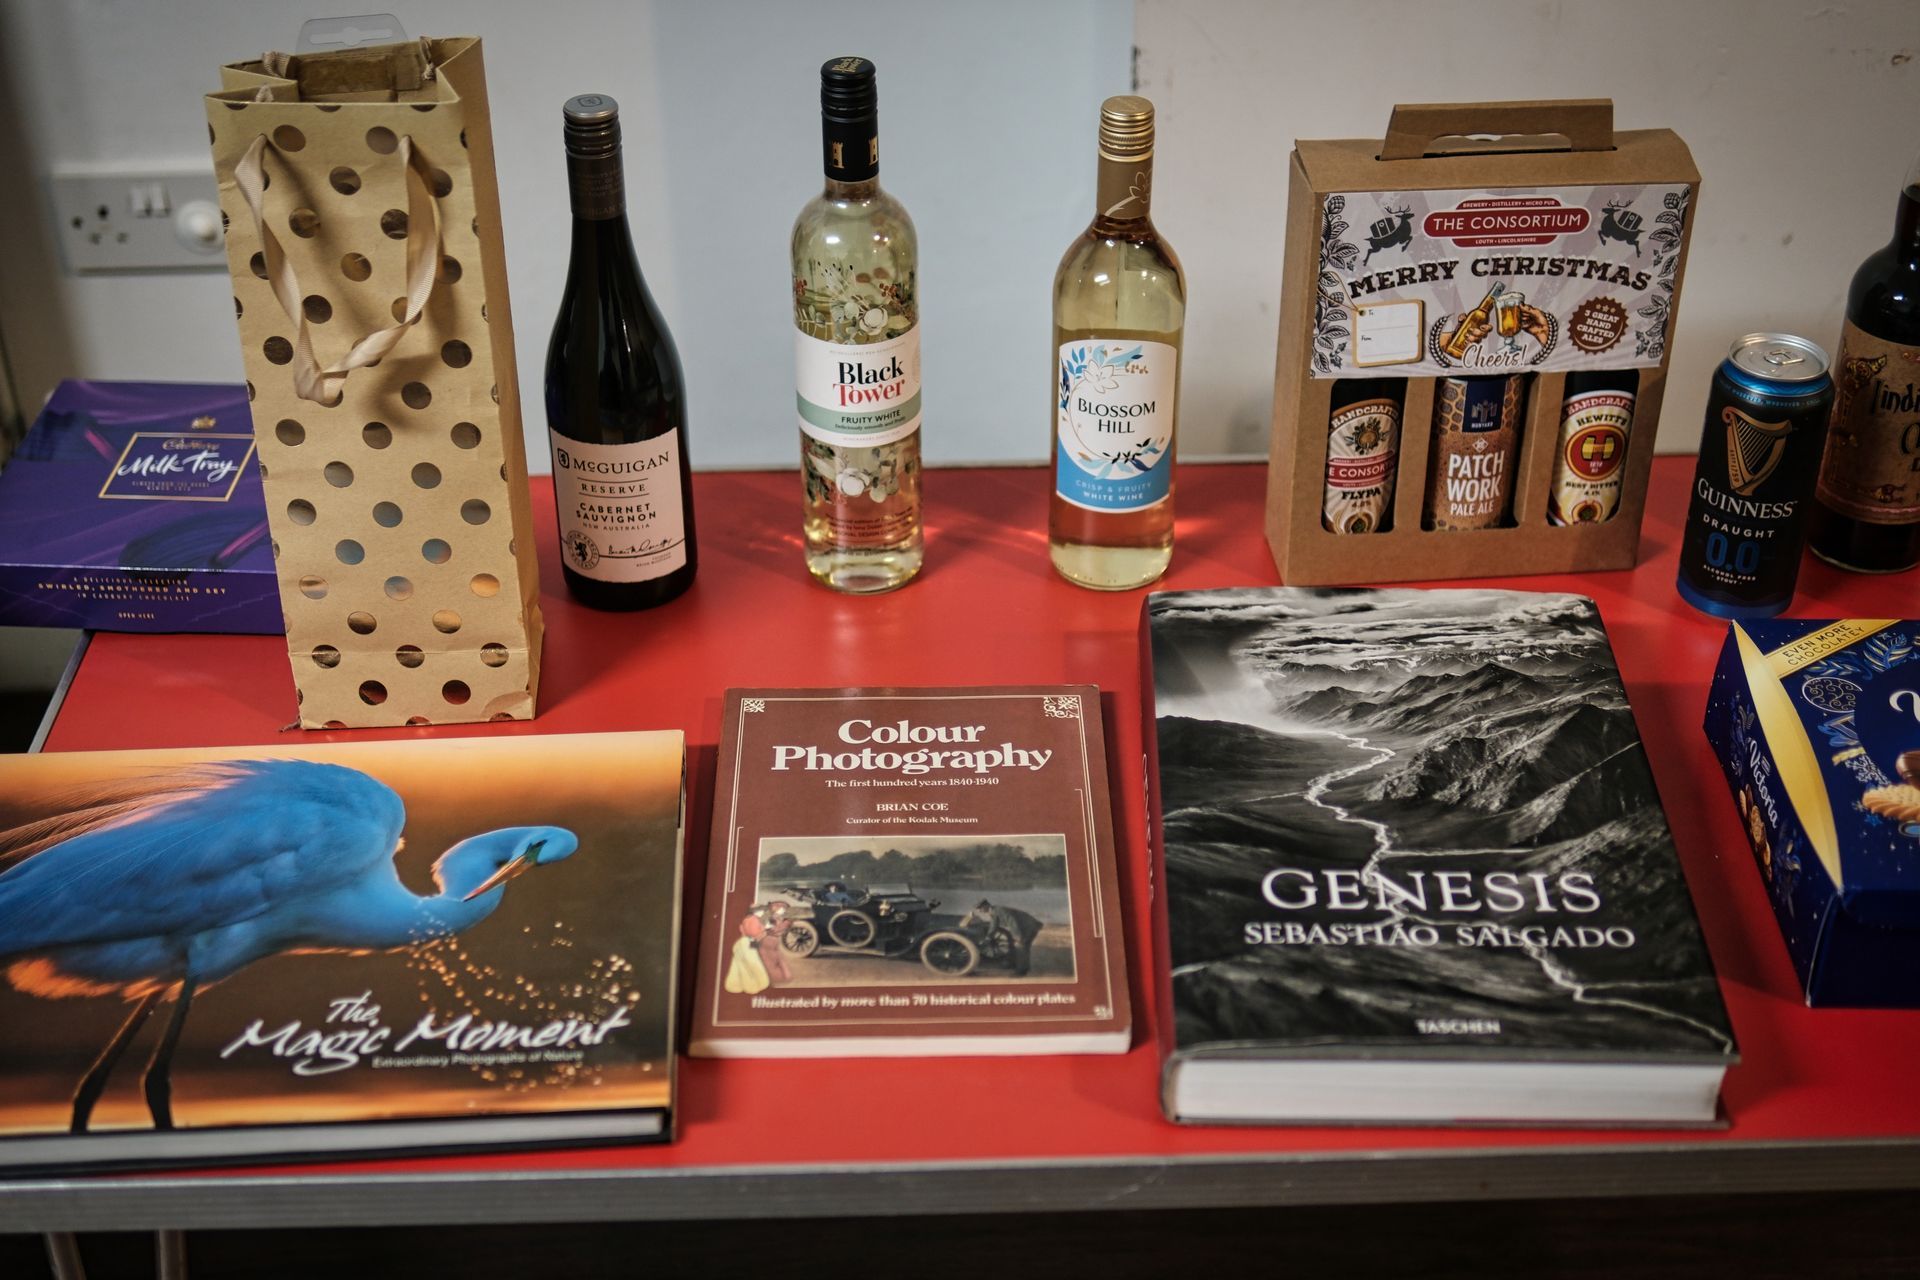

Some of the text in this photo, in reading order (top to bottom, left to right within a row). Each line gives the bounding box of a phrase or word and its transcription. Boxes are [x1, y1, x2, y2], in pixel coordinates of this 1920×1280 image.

[1433, 214, 1581, 231] THE CONSORTIUM
[1347, 255, 1653, 300] MERRY CHRISTMAS
[1586, 318, 1612, 329] HAND
[1592, 311, 1620, 323] GREAT
[1576, 324, 1615, 338] CRAFTED
[1581, 333, 1604, 344] ALES
[1463, 344, 1527, 368] Cheers!
[838, 356, 905, 385] Black
[832, 379, 906, 407] Tower
[841, 410, 901, 424] FRUITY WHITE
[1078, 398, 1156, 418] BLOSSOM
[1098, 419, 1136, 434] HILL
[117, 450, 240, 483] Milk Tray
[573, 451, 670, 475] McGUIGAN
[1448, 450, 1505, 478] PATCH
[581, 483, 646, 494] RESERVE
[1076, 479, 1102, 492] CRISP
[1118, 481, 1152, 492] FRUITY
[1447, 475, 1501, 502] WORK
[1083, 491, 1144, 502] WHITE WINE
[1698, 478, 1793, 519] GUINNESS
[576, 511, 656, 523] SAUVIGNON
[580, 502, 651, 514] CABERNET
[1450, 500, 1494, 516] PALE ALE
[1703, 514, 1775, 538] DRAUGHT
[1706, 532, 1760, 574] 0.0
[1703, 564, 1734, 578] ALCOHOL
[99, 585, 170, 593] SMOTHERED
[1782, 624, 1852, 658] EVEN MORE
[1788, 626, 1865, 666] CHOCOLATEY
[838, 719, 986, 745] Colour
[771, 742, 1053, 775] Photography
[825, 777, 1000, 788] The first hundred years 1840-1940
[1749, 739, 1778, 829] Victoria
[876, 802, 949, 812] BRIAN COE
[846, 815, 978, 825] Curator of the Kodak Museum
[1261, 868, 1601, 913] GENESIS
[1244, 921, 1636, 949] SEBASTIÃO SALGADO
[326, 989, 382, 1027] The
[751, 991, 1076, 1009] Illustrated by more than 70 historical colour plates
[1415, 1018, 1501, 1035] TASCHEN
[220, 1005, 631, 1077] Magic Moment
